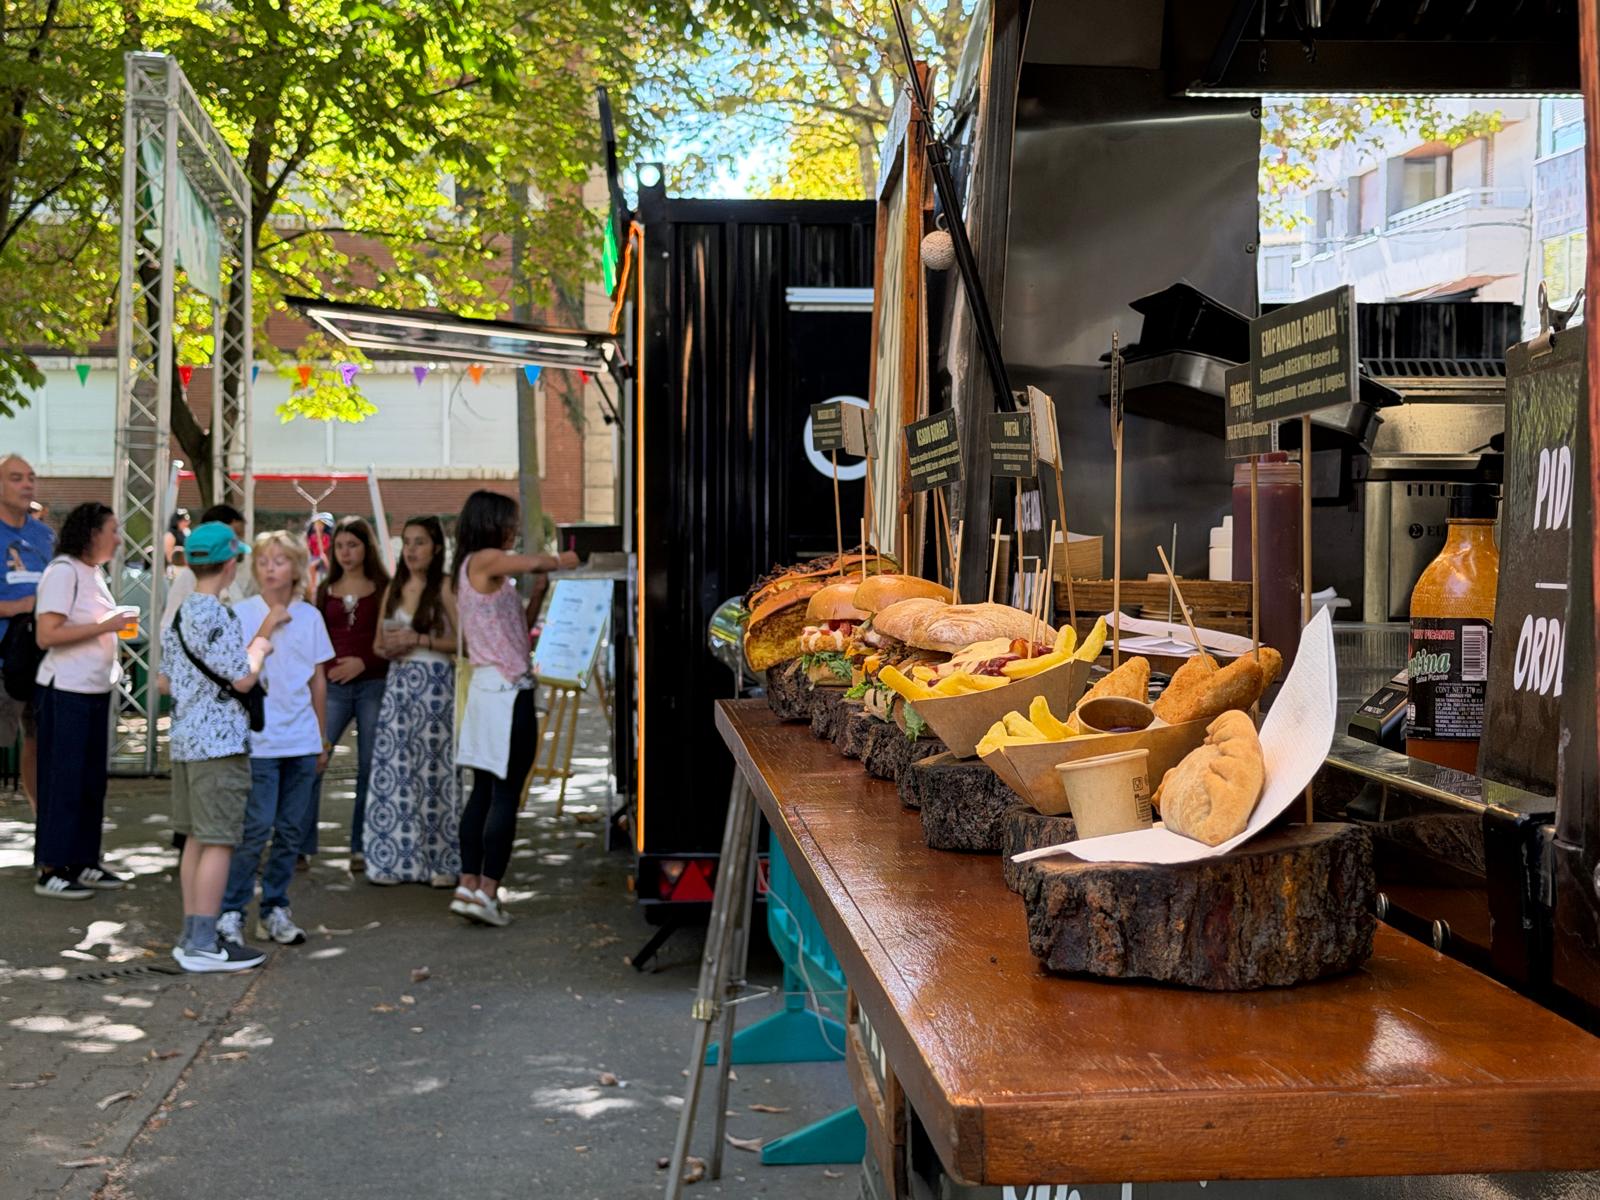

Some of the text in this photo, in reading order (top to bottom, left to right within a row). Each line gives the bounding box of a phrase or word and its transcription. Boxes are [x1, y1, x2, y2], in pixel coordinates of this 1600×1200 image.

[1261, 306, 1337, 358] EMPANADA CRIOLLA
[1533, 445, 1575, 531] PID
[1424, 629, 1456, 641] PICANTE
[1427, 673, 1449, 682] Picante
